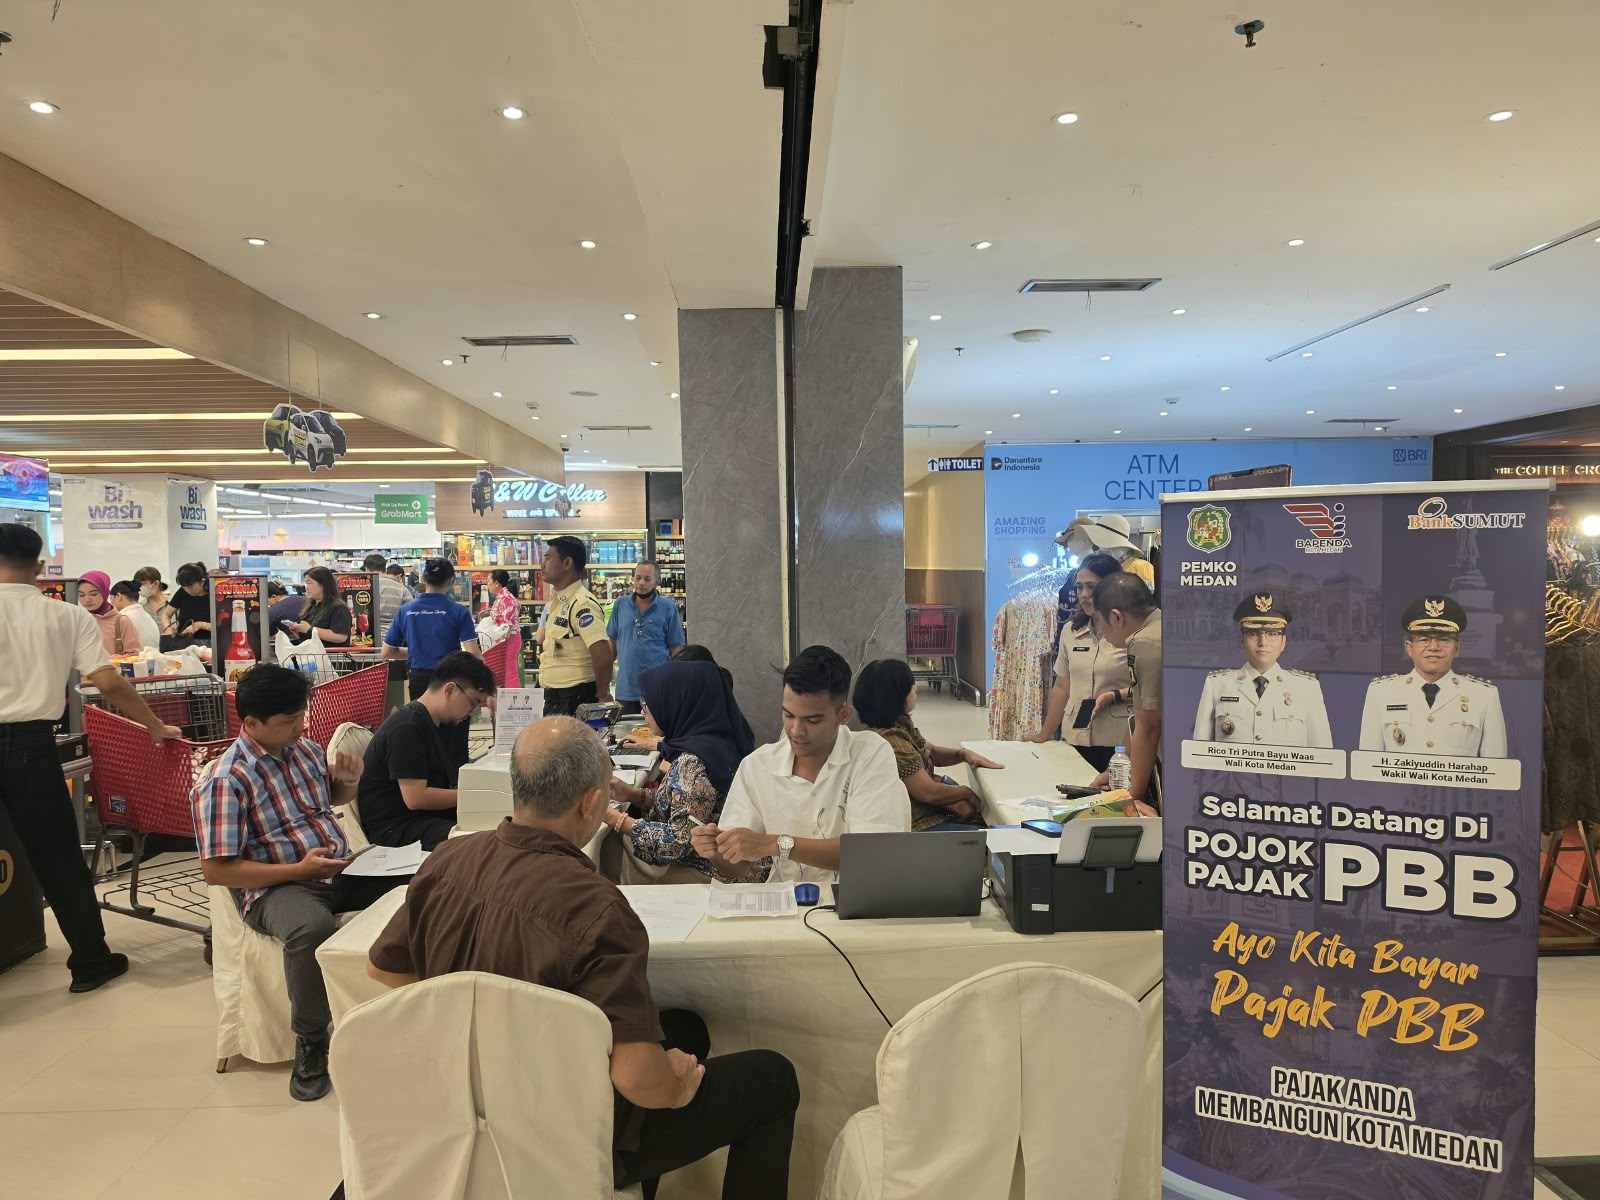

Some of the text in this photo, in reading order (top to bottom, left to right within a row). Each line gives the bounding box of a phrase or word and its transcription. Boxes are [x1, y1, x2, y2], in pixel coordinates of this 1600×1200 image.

[1004, 456, 1043, 464] Danantara
[1407, 449, 1427, 461] BRI
[951, 458, 982, 470] TOILET
[1004, 463, 1041, 471] Indonesia
[1127, 454, 1179, 474] ATM
[187, 486, 199, 505] Bi
[87, 500, 143, 520] wash
[179, 503, 207, 521] wash
[380, 509, 423, 518] GrabMart
[994, 516, 1047, 526] AMAZING
[994, 525, 1047, 535] SHOPPING
[1295, 538, 1353, 549] BAPENDA
[1180, 560, 1237, 573] PEMKO
[1180, 574, 1238, 587] MEDAN
[1207, 746, 1315, 761] Rico Tri Putra Bayu Waas
[1225, 759, 1296, 771] Wali Kota Medan
[1381, 757, 1488, 774] H. Zakiyuddin Harahap
[1381, 769, 1488, 784] Wakil Wali Kota Medan
[1202, 795, 1489, 840] Selamat Datang Di
[1187, 829, 1518, 919] POJOK PBB
[1187, 860, 1309, 899] PAJAK
[1212, 921, 1479, 990] Ayo Kita Bayar
[1210, 969, 1485, 1052] Pajak PBB
[1272, 1068, 1414, 1118] PAJAK ANDA
[1197, 1088, 1501, 1170] MEMBANGUN KOTA MEDAN
